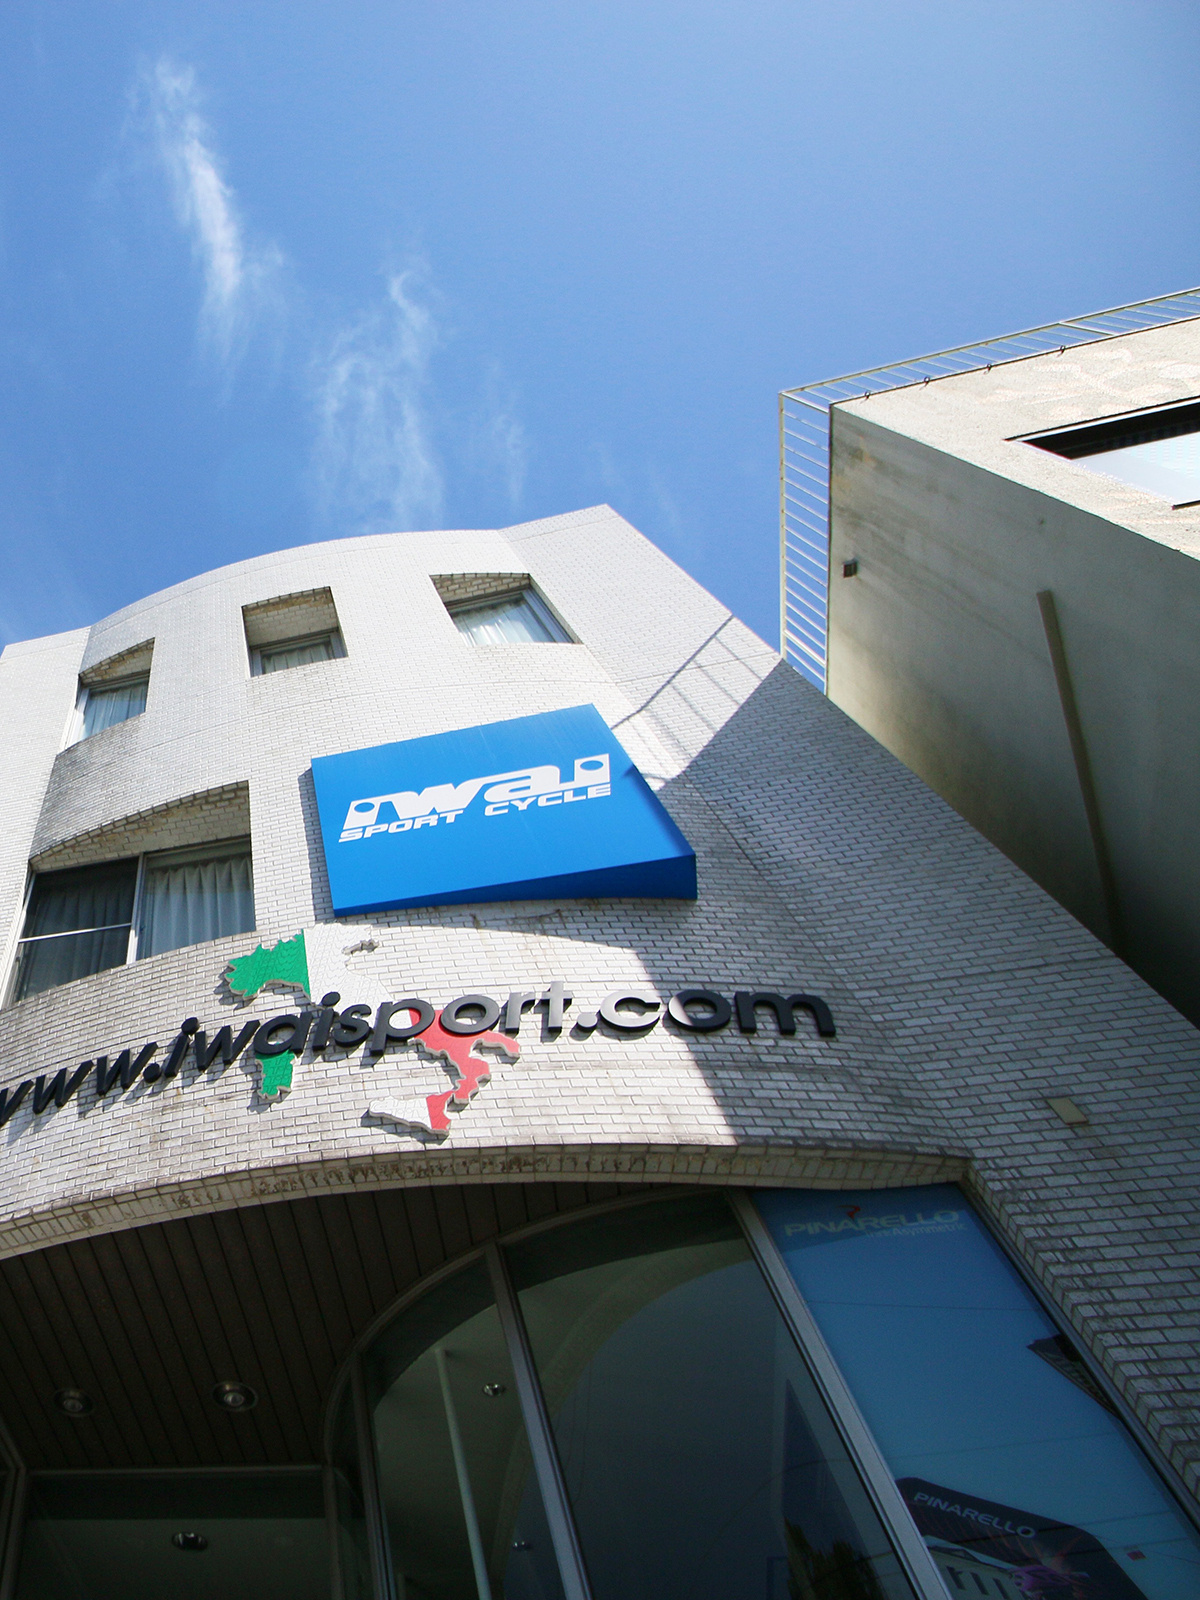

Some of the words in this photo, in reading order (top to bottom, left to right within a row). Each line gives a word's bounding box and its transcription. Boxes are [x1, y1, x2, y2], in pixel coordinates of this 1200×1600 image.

[338, 810, 464, 843] SPORT
[484, 783, 612, 817] CYCLE
[783, 1209, 960, 1237] PINARELLO
[914, 1492, 1037, 1539] PINARELLO
